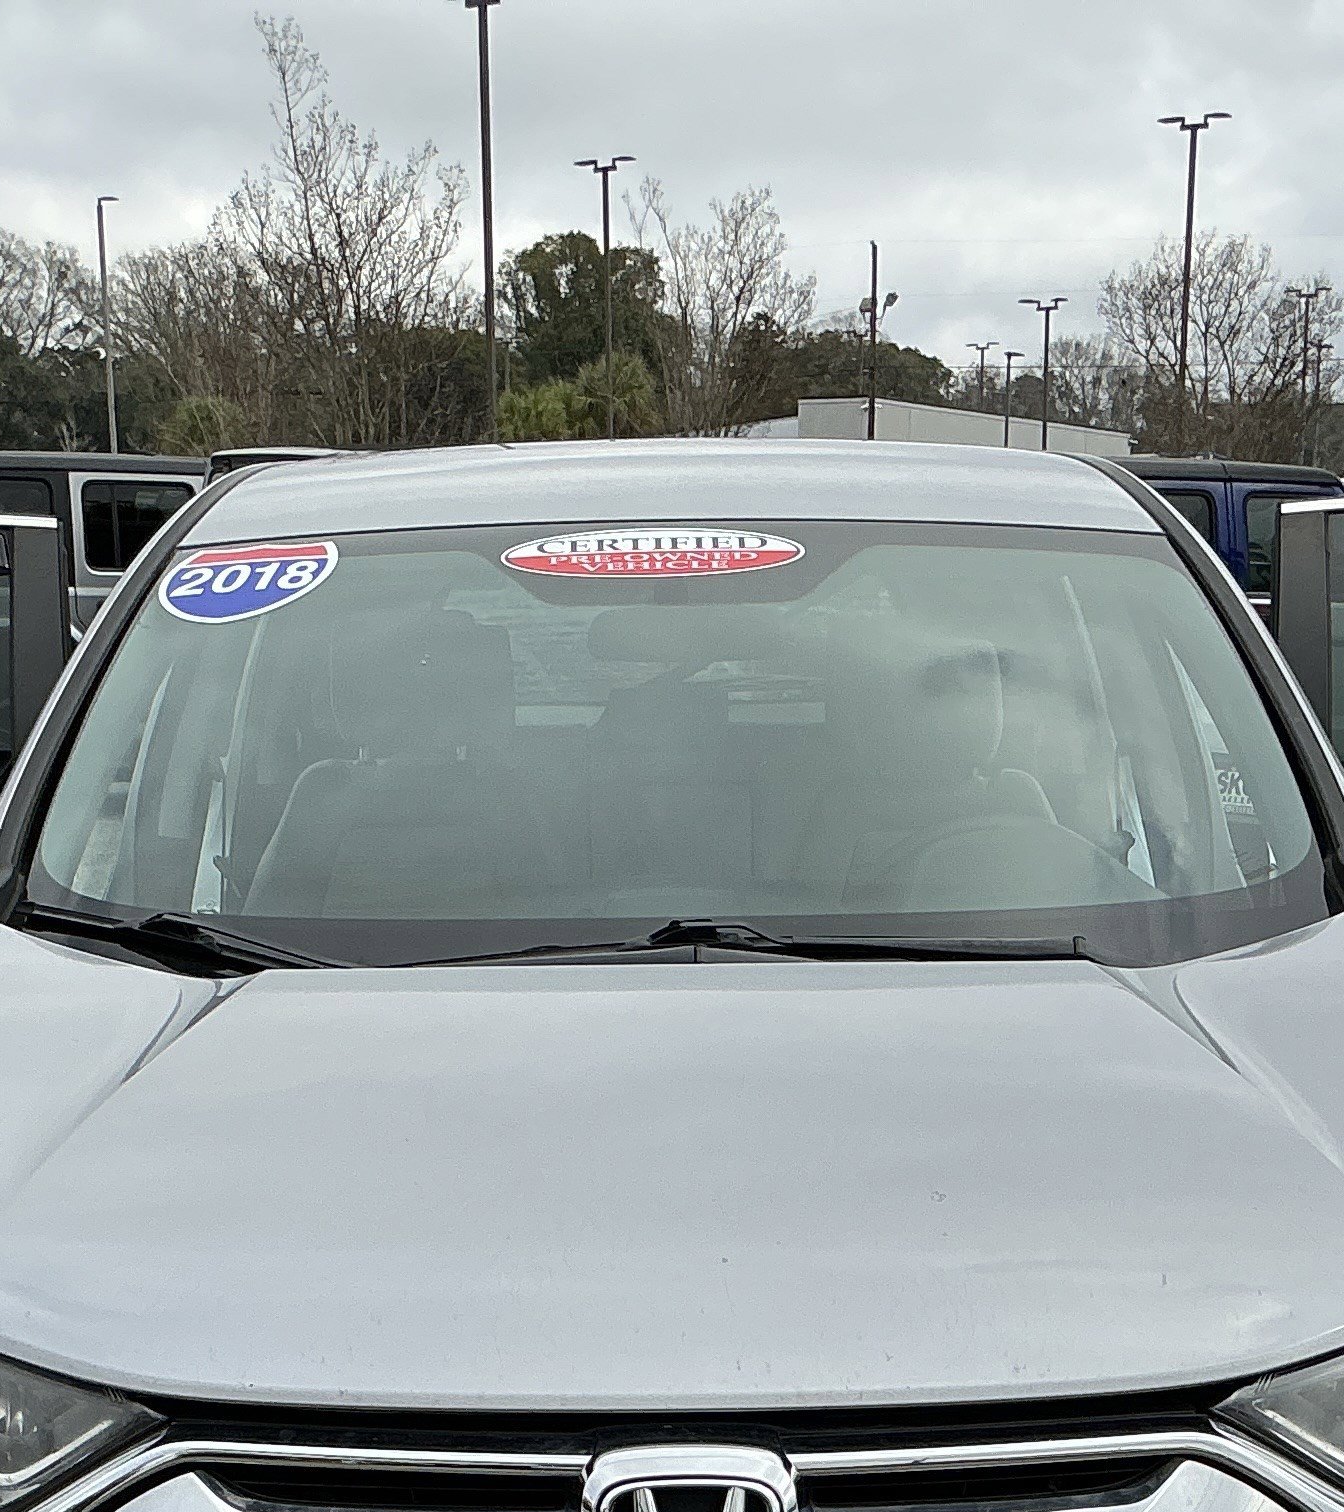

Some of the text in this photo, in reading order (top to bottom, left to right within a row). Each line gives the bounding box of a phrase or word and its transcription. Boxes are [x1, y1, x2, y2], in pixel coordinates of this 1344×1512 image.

[537, 536, 768, 554] CERTIFIED
[548, 551, 759, 565] PRE-OWNED
[579, 559, 731, 572] VEHICLE
[169, 560, 319, 598] 2018
